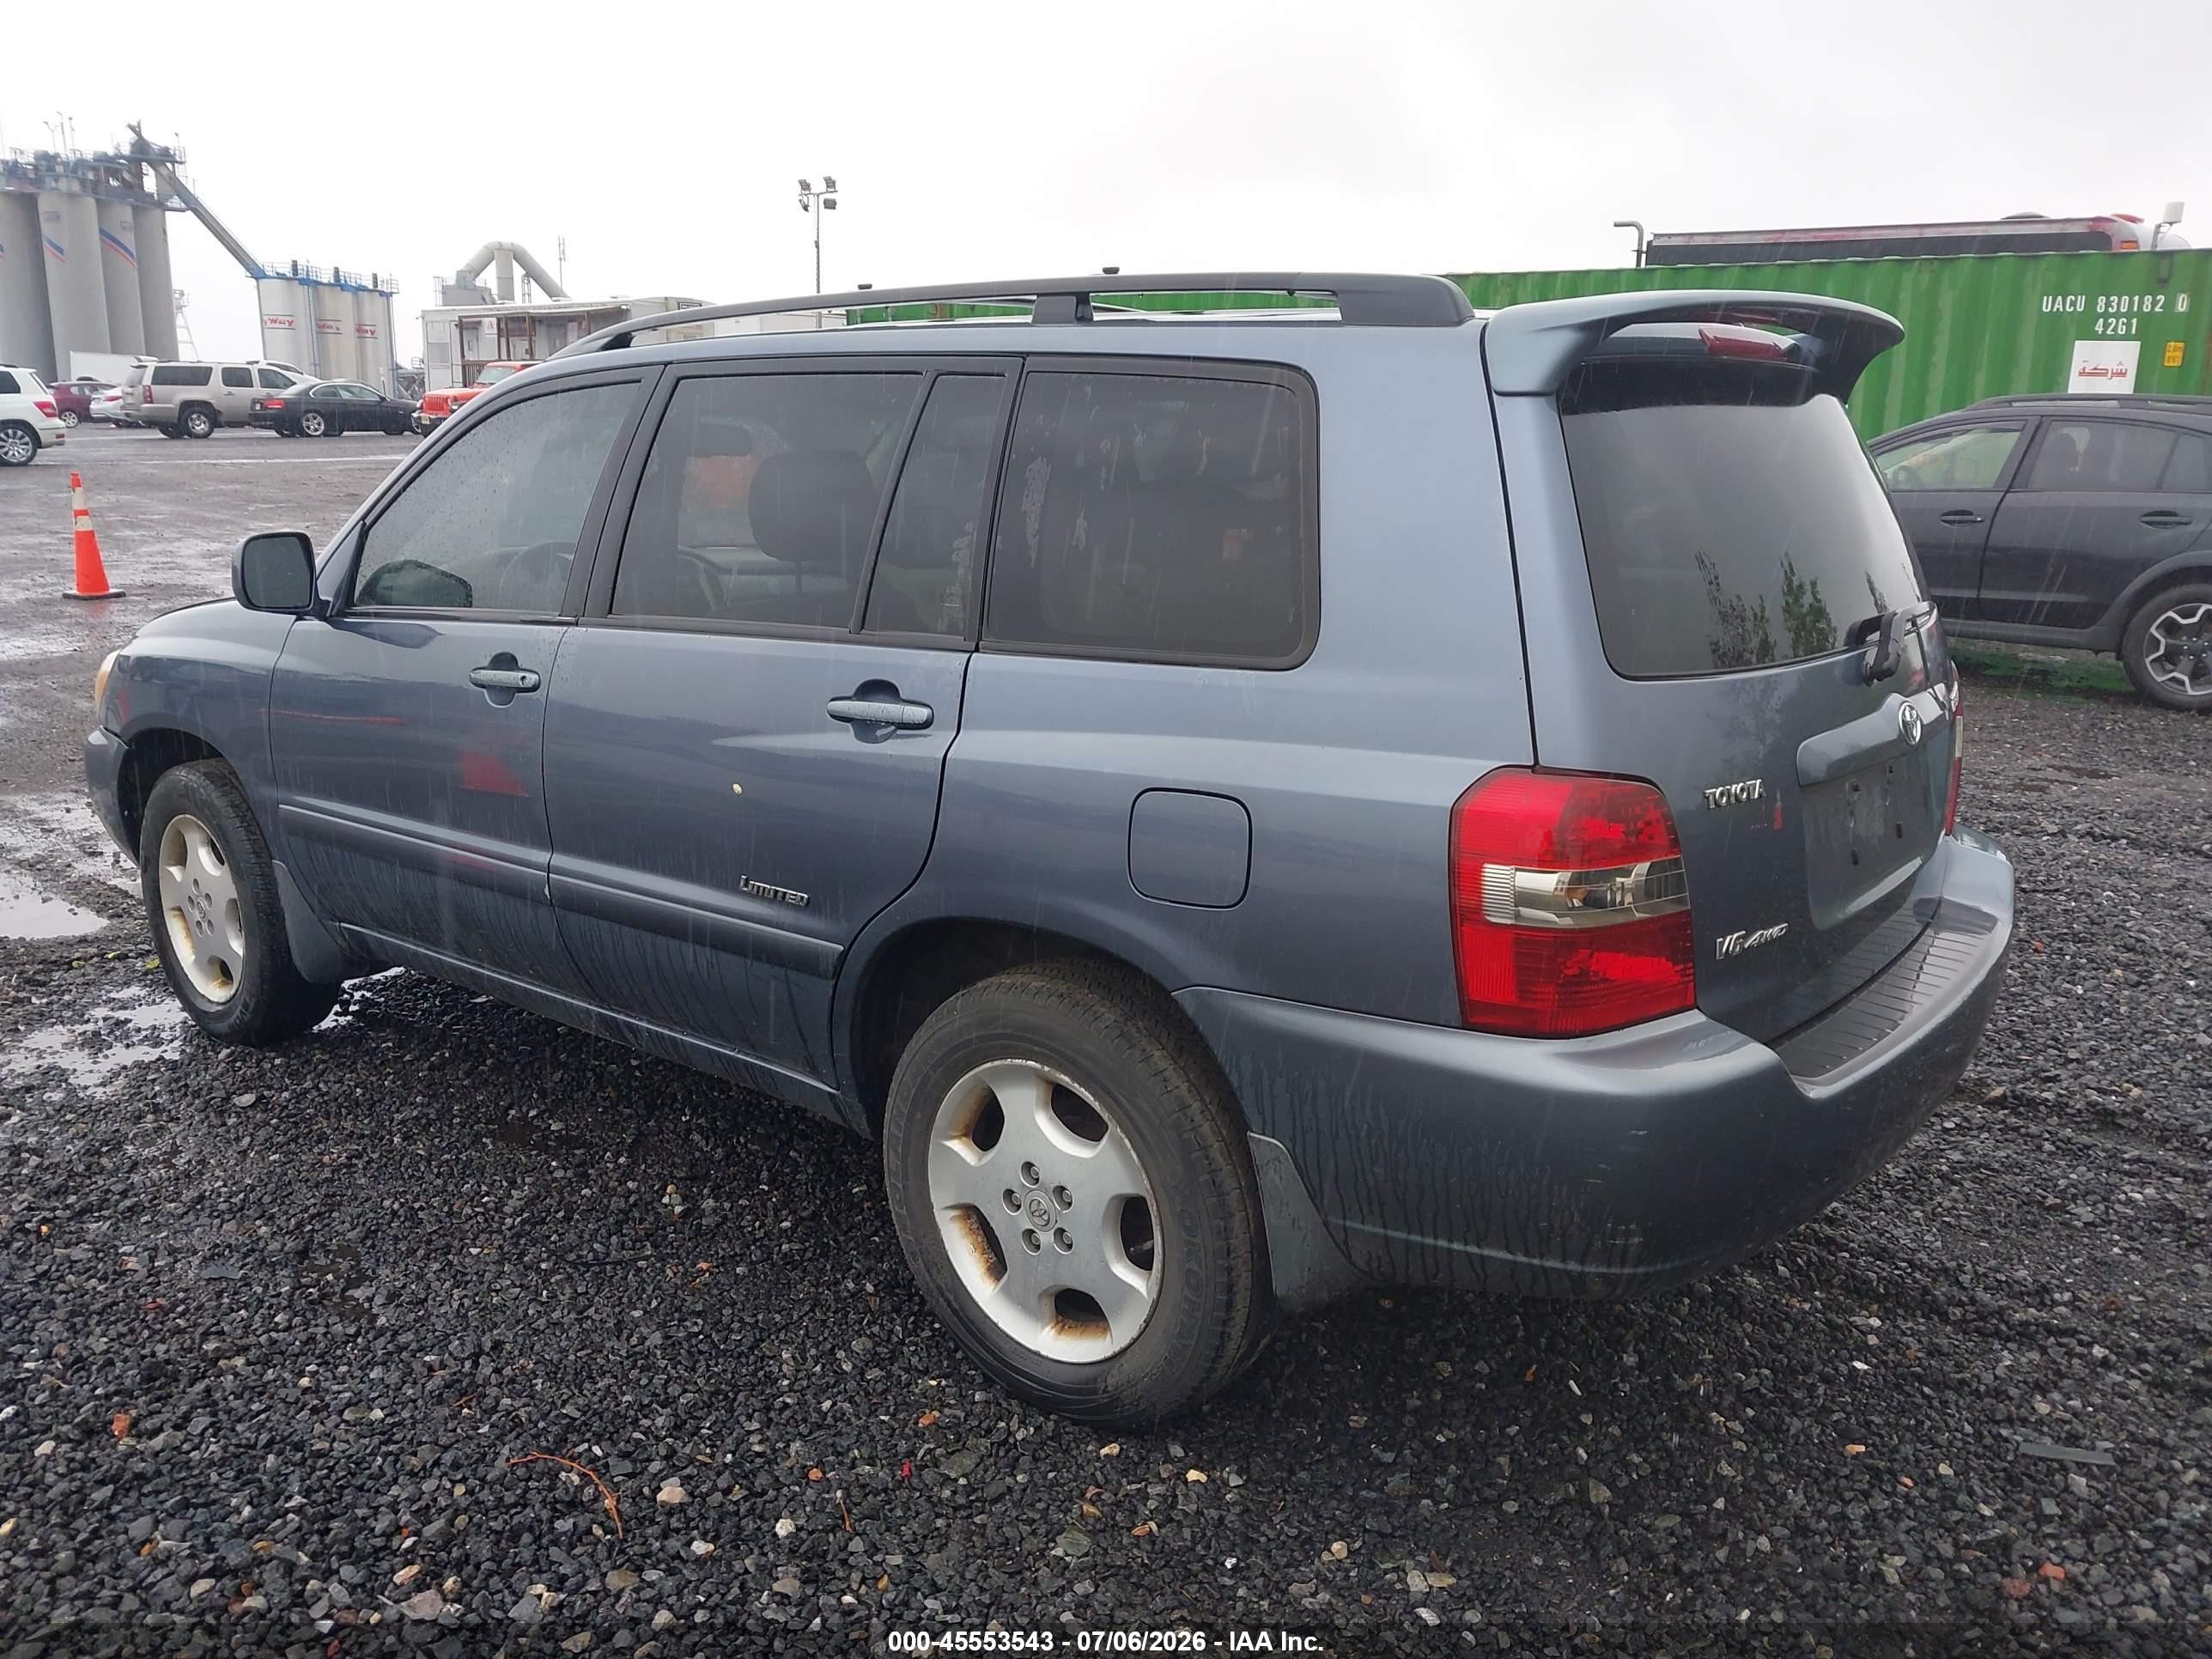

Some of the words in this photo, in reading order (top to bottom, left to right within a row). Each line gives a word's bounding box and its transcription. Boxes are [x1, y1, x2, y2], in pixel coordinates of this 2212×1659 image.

[2042, 295, 2086, 312] UACU
[2096, 295, 2166, 313] 830182
[2094, 318, 2138, 335] 42G1
[2077, 361, 2128, 380] شركة
[1705, 779, 1766, 809] TOYOTA
[1716, 930, 1747, 960] V6
